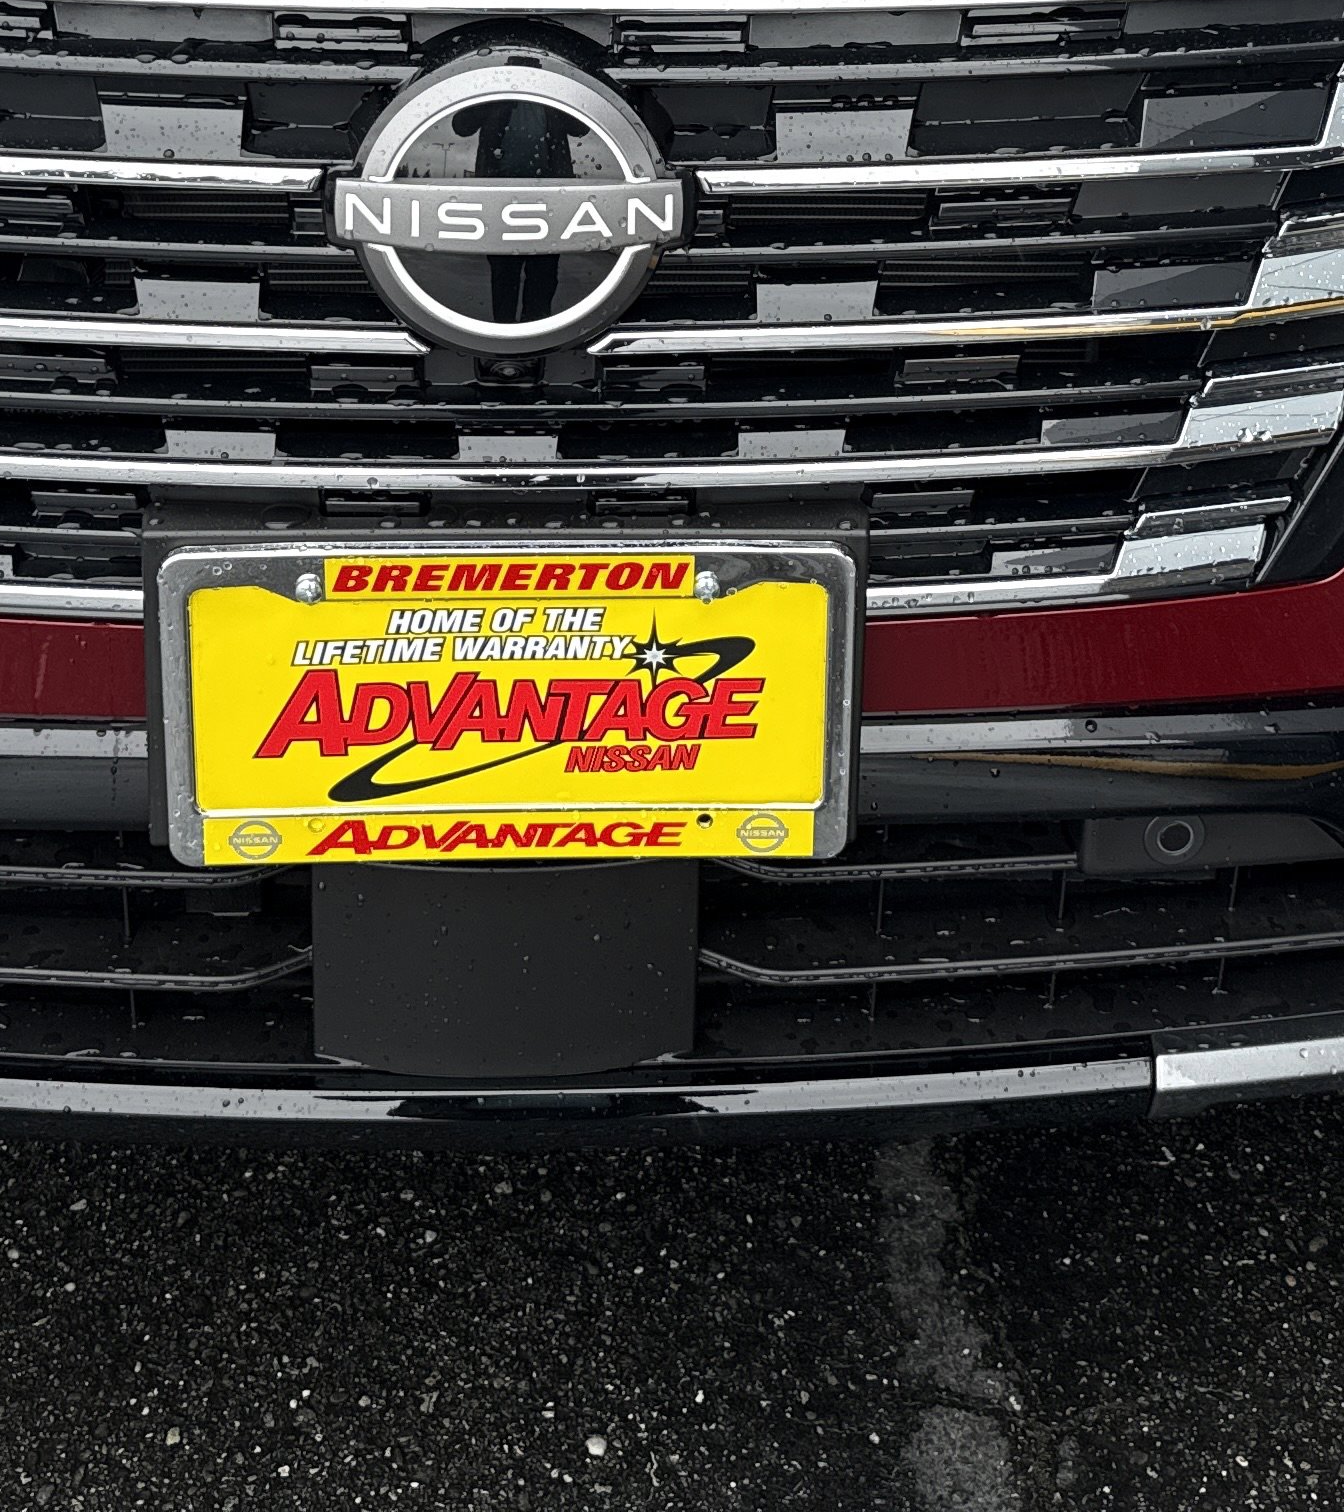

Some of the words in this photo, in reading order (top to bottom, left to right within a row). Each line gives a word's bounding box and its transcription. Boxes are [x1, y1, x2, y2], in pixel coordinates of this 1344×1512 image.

[344, 192, 674, 242] NISSAN
[331, 561, 691, 593] BREMERTON
[385, 607, 484, 636] HOME
[489, 607, 536, 634] OF
[542, 606, 607, 633] THE
[292, 636, 448, 667] LIFETIME
[451, 635, 635, 662] WARRANTY
[253, 669, 766, 759] ADVANTAGE
[564, 744, 702, 774] NISSAN
[230, 835, 281, 847] NISSAN
[306, 819, 689, 857] ADVANTAGE
[739, 829, 788, 840] NISSAN
